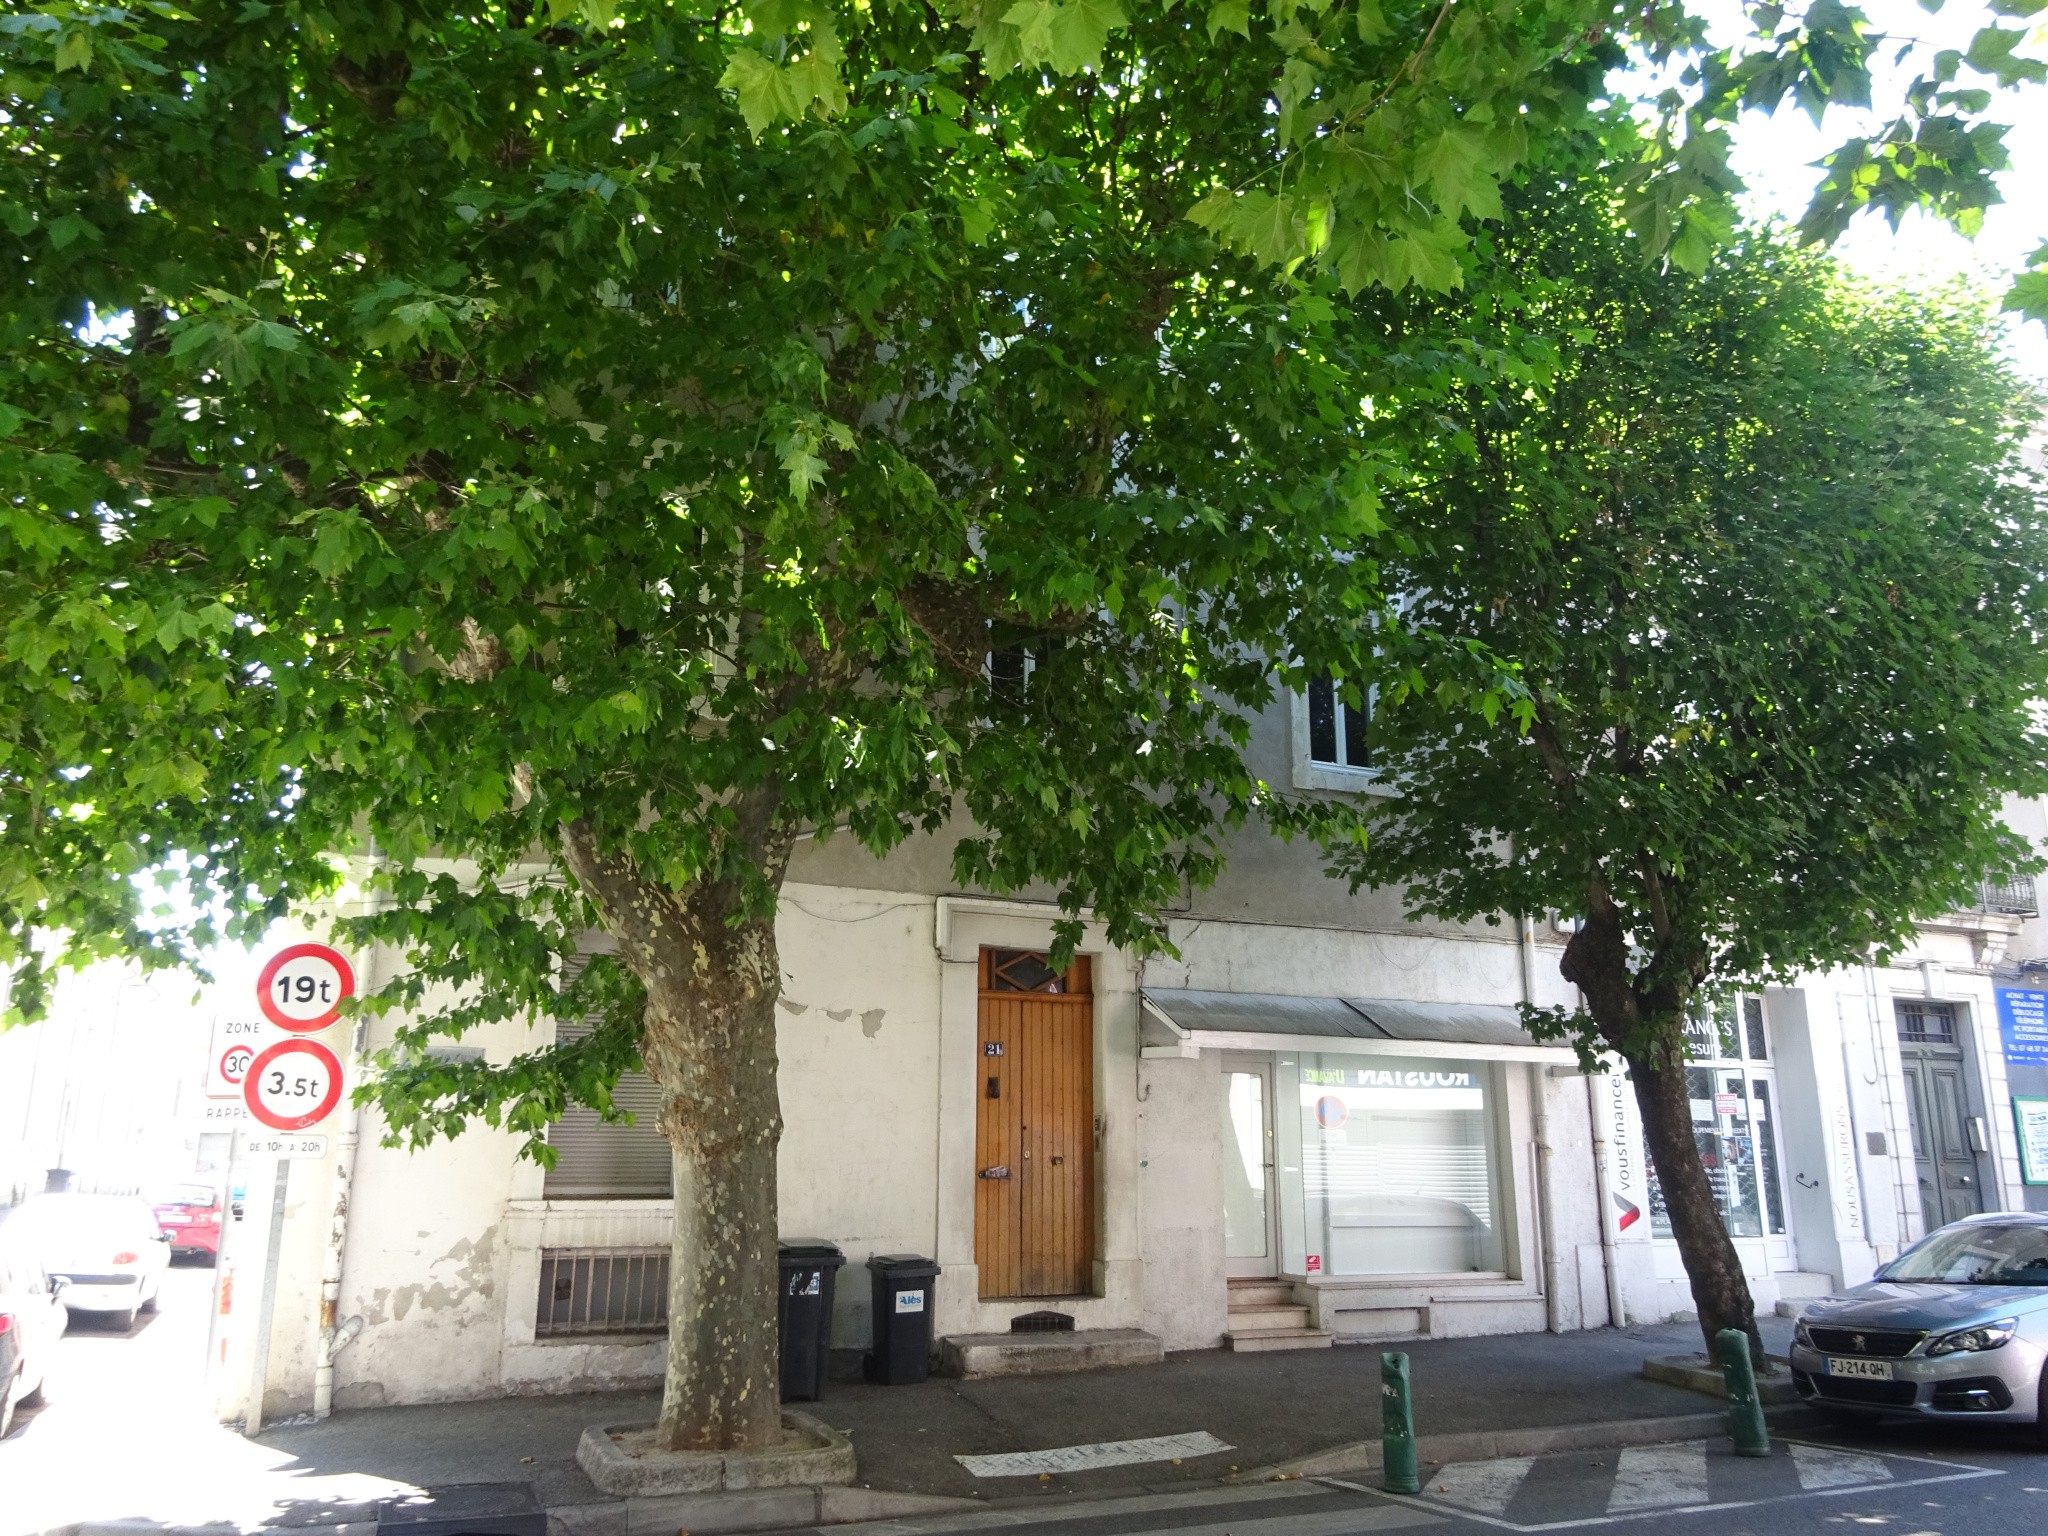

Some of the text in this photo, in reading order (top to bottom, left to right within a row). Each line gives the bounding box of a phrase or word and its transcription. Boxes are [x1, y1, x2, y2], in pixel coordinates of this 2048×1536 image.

[226, 1022, 261, 1033] ZONE
[986, 1043, 1001, 1055] 21
[227, 1056, 250, 1073] 30
[267, 1071, 319, 1098] 3.5t
[206, 1108, 249, 1119] RAPPE
[249, 1142, 261, 1152] DE
[301, 1141, 321, 1152] 20h
